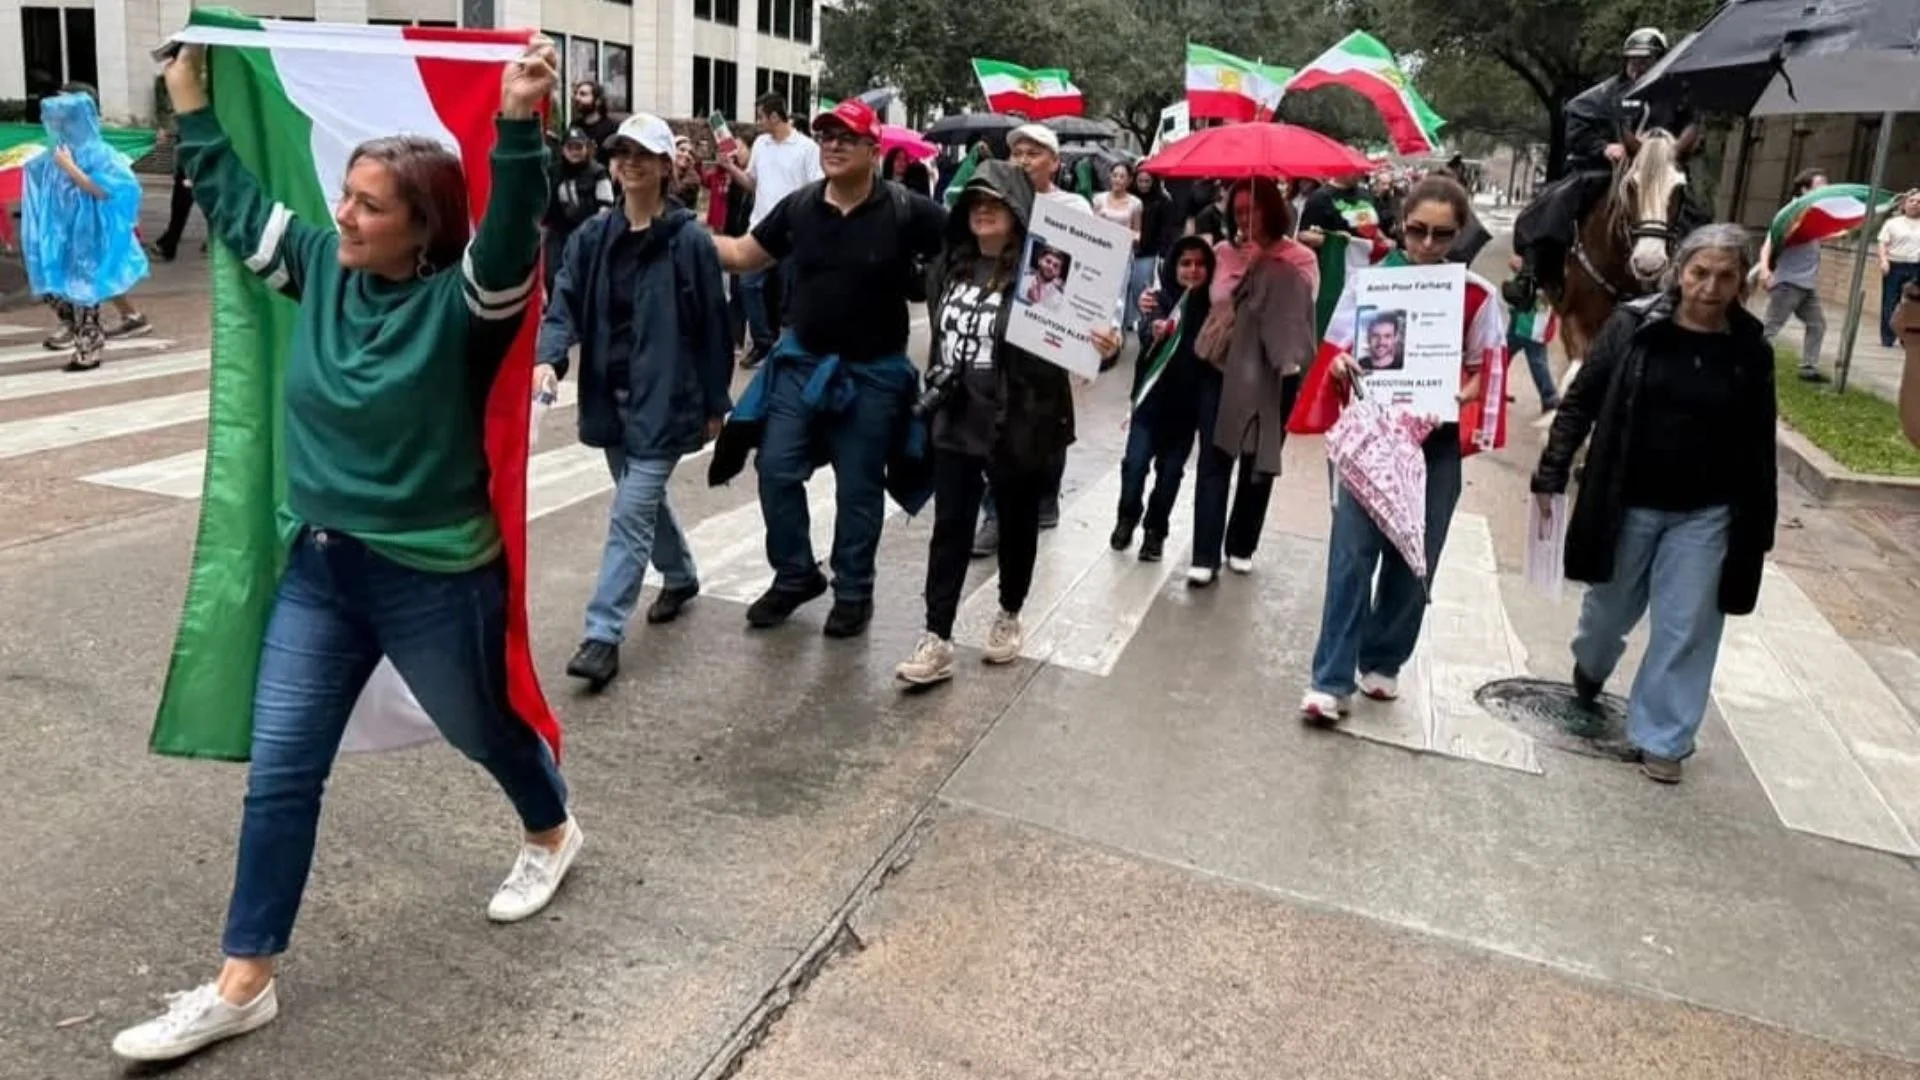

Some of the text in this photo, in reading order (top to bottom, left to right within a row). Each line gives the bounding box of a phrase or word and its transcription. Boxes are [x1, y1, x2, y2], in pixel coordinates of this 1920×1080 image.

[1391, 282, 1412, 291] Pour
[1414, 281, 1452, 291] Farhang
[1024, 309, 1066, 333] EXECUTION
[1066, 328, 1092, 343] ALERT
[1366, 379, 1442, 387] EXECUTION ALERT
